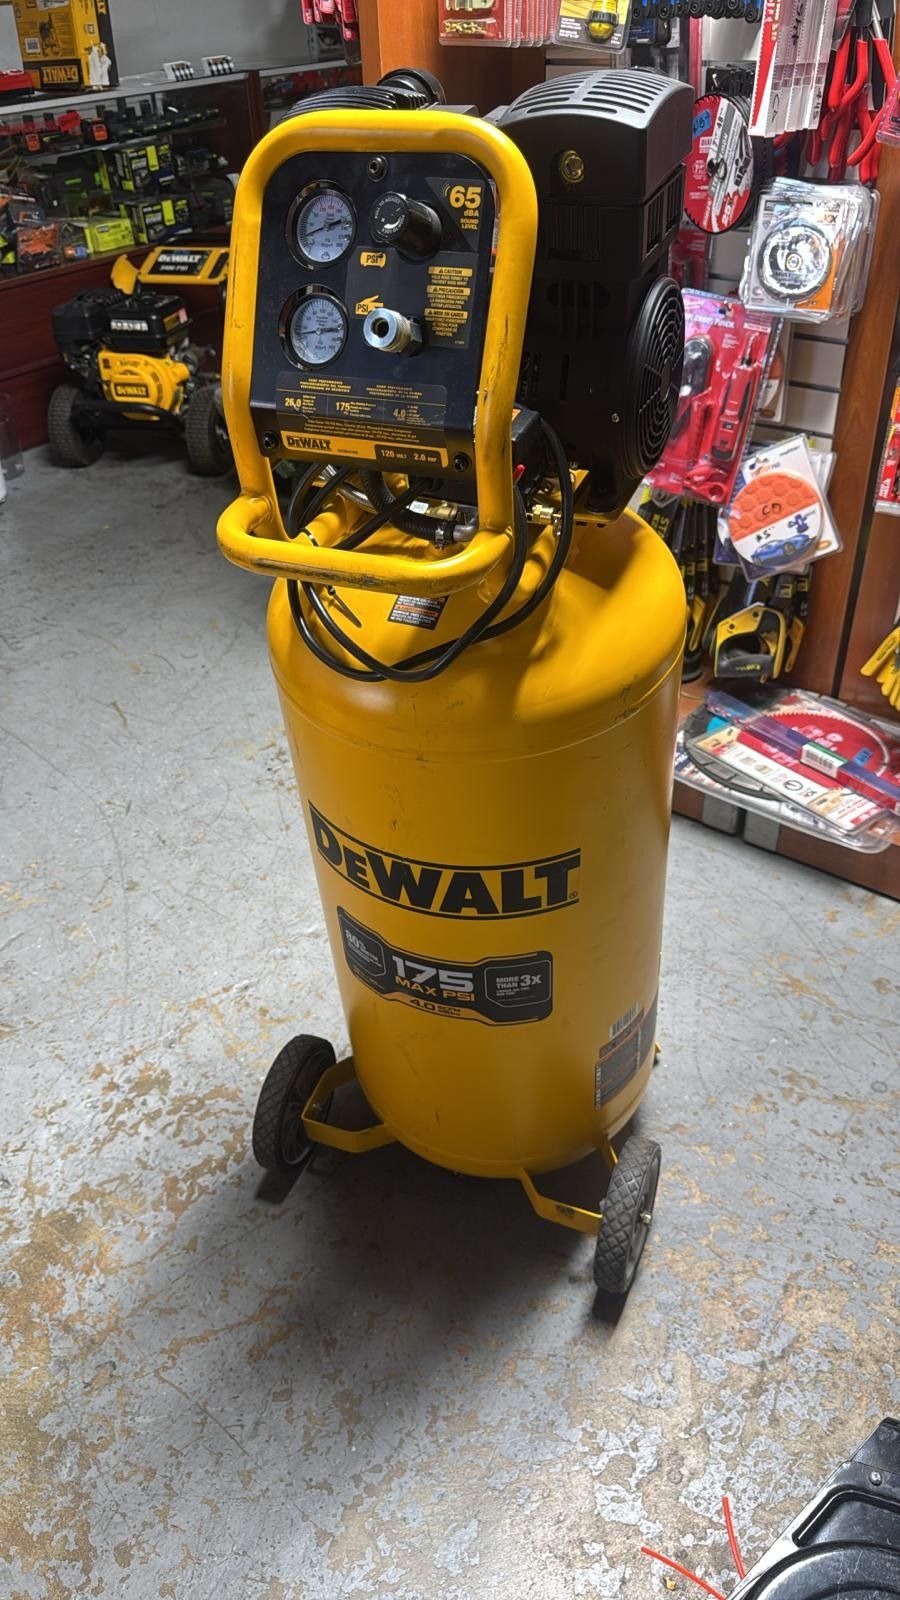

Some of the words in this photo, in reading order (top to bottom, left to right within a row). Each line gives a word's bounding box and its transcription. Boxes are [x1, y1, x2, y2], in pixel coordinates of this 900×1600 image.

[450, 186, 481, 209] 65
[366, 254, 379, 264] PSI
[357, 304, 369, 313] PSI
[336, 402, 350, 411] 175
[393, 408, 406, 418] 4.0
[287, 437, 331, 450] DEWALT
[381, 450, 394, 458] 120
[413, 453, 426, 461] 2.0
[309, 804, 581, 914] DEWALT
[392, 955, 474, 993] 175
[520, 974, 542, 987] 3X
[395, 975, 438, 997] MAX
[442, 989, 475, 1002] PSI
[496, 981, 518, 989] THAN
[411, 998, 436, 1011] 4.0
